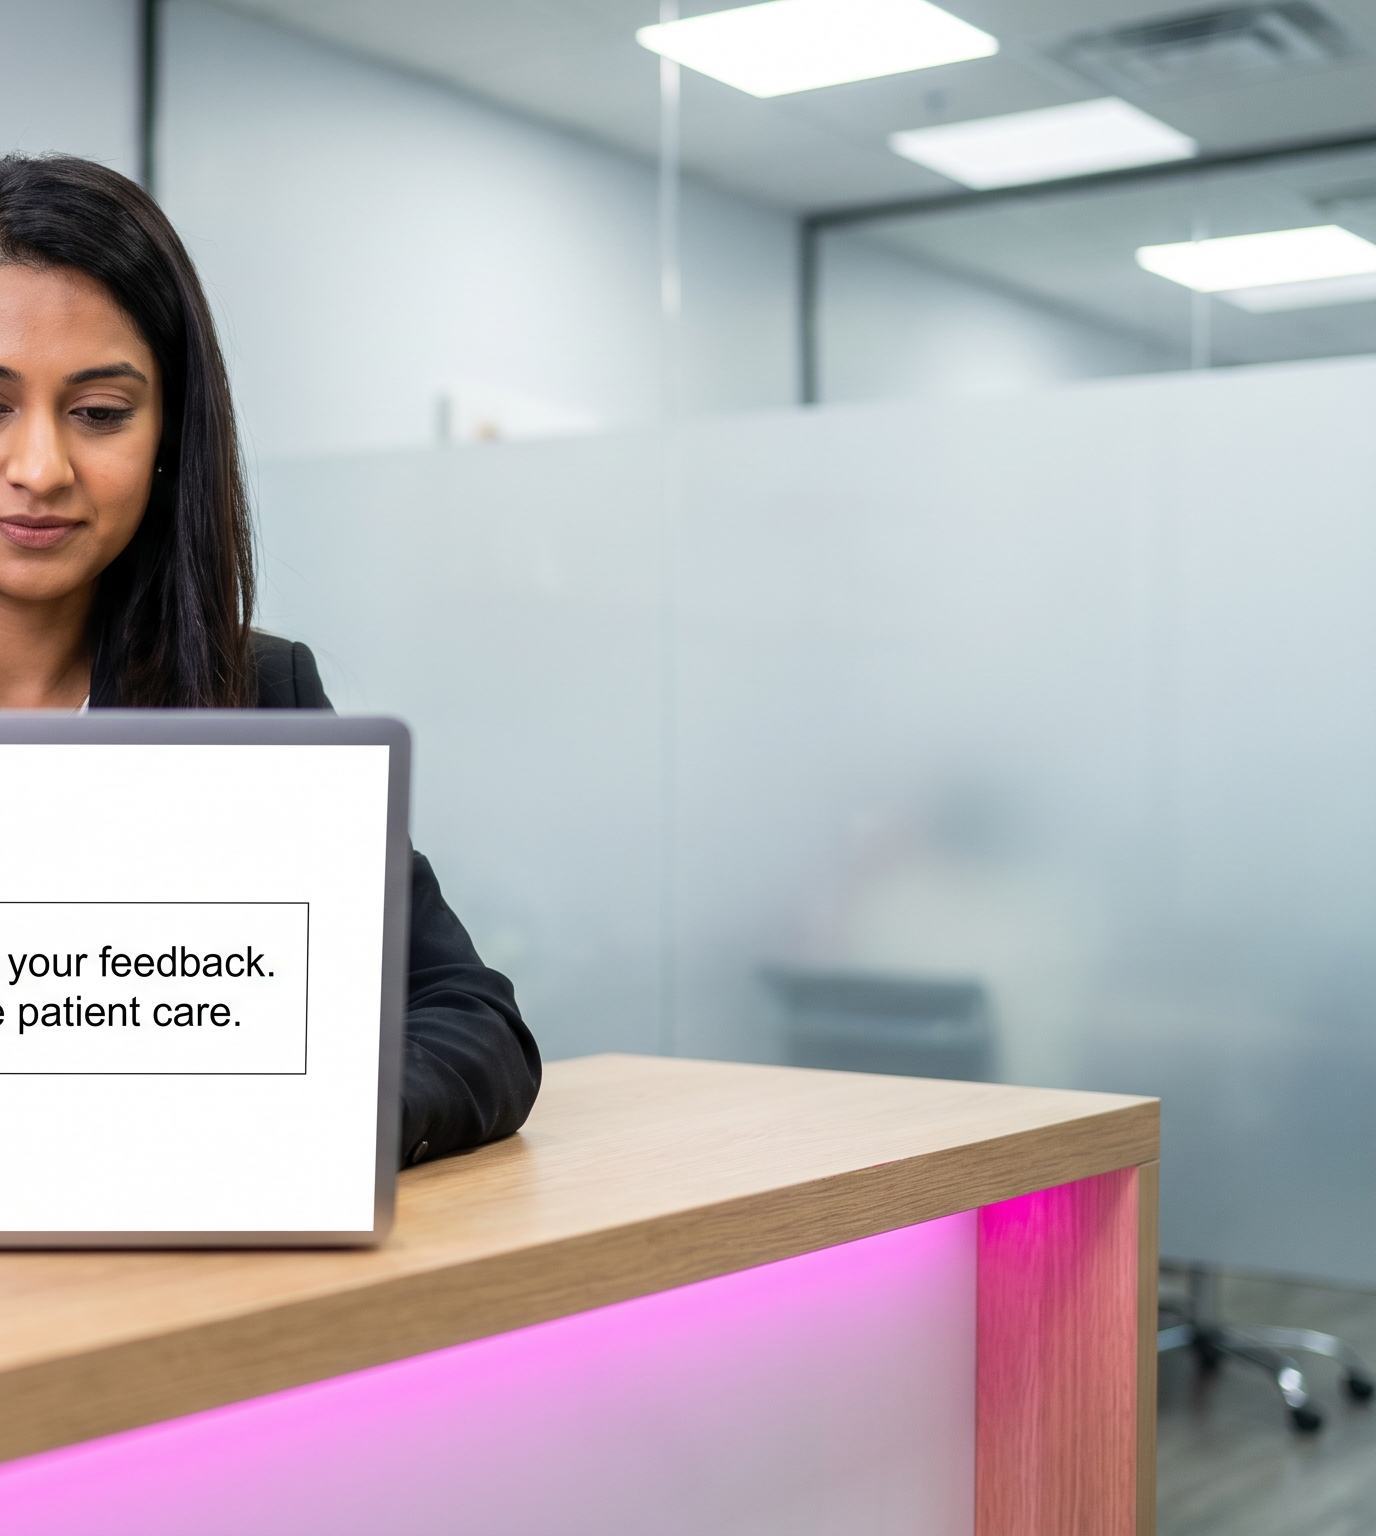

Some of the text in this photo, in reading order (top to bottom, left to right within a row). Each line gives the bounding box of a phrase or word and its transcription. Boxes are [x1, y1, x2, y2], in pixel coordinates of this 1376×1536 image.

[7, 953, 89, 986] your
[98, 944, 274, 978] feedback.
[19, 995, 141, 1035] patient
[153, 1003, 241, 1027] care.
